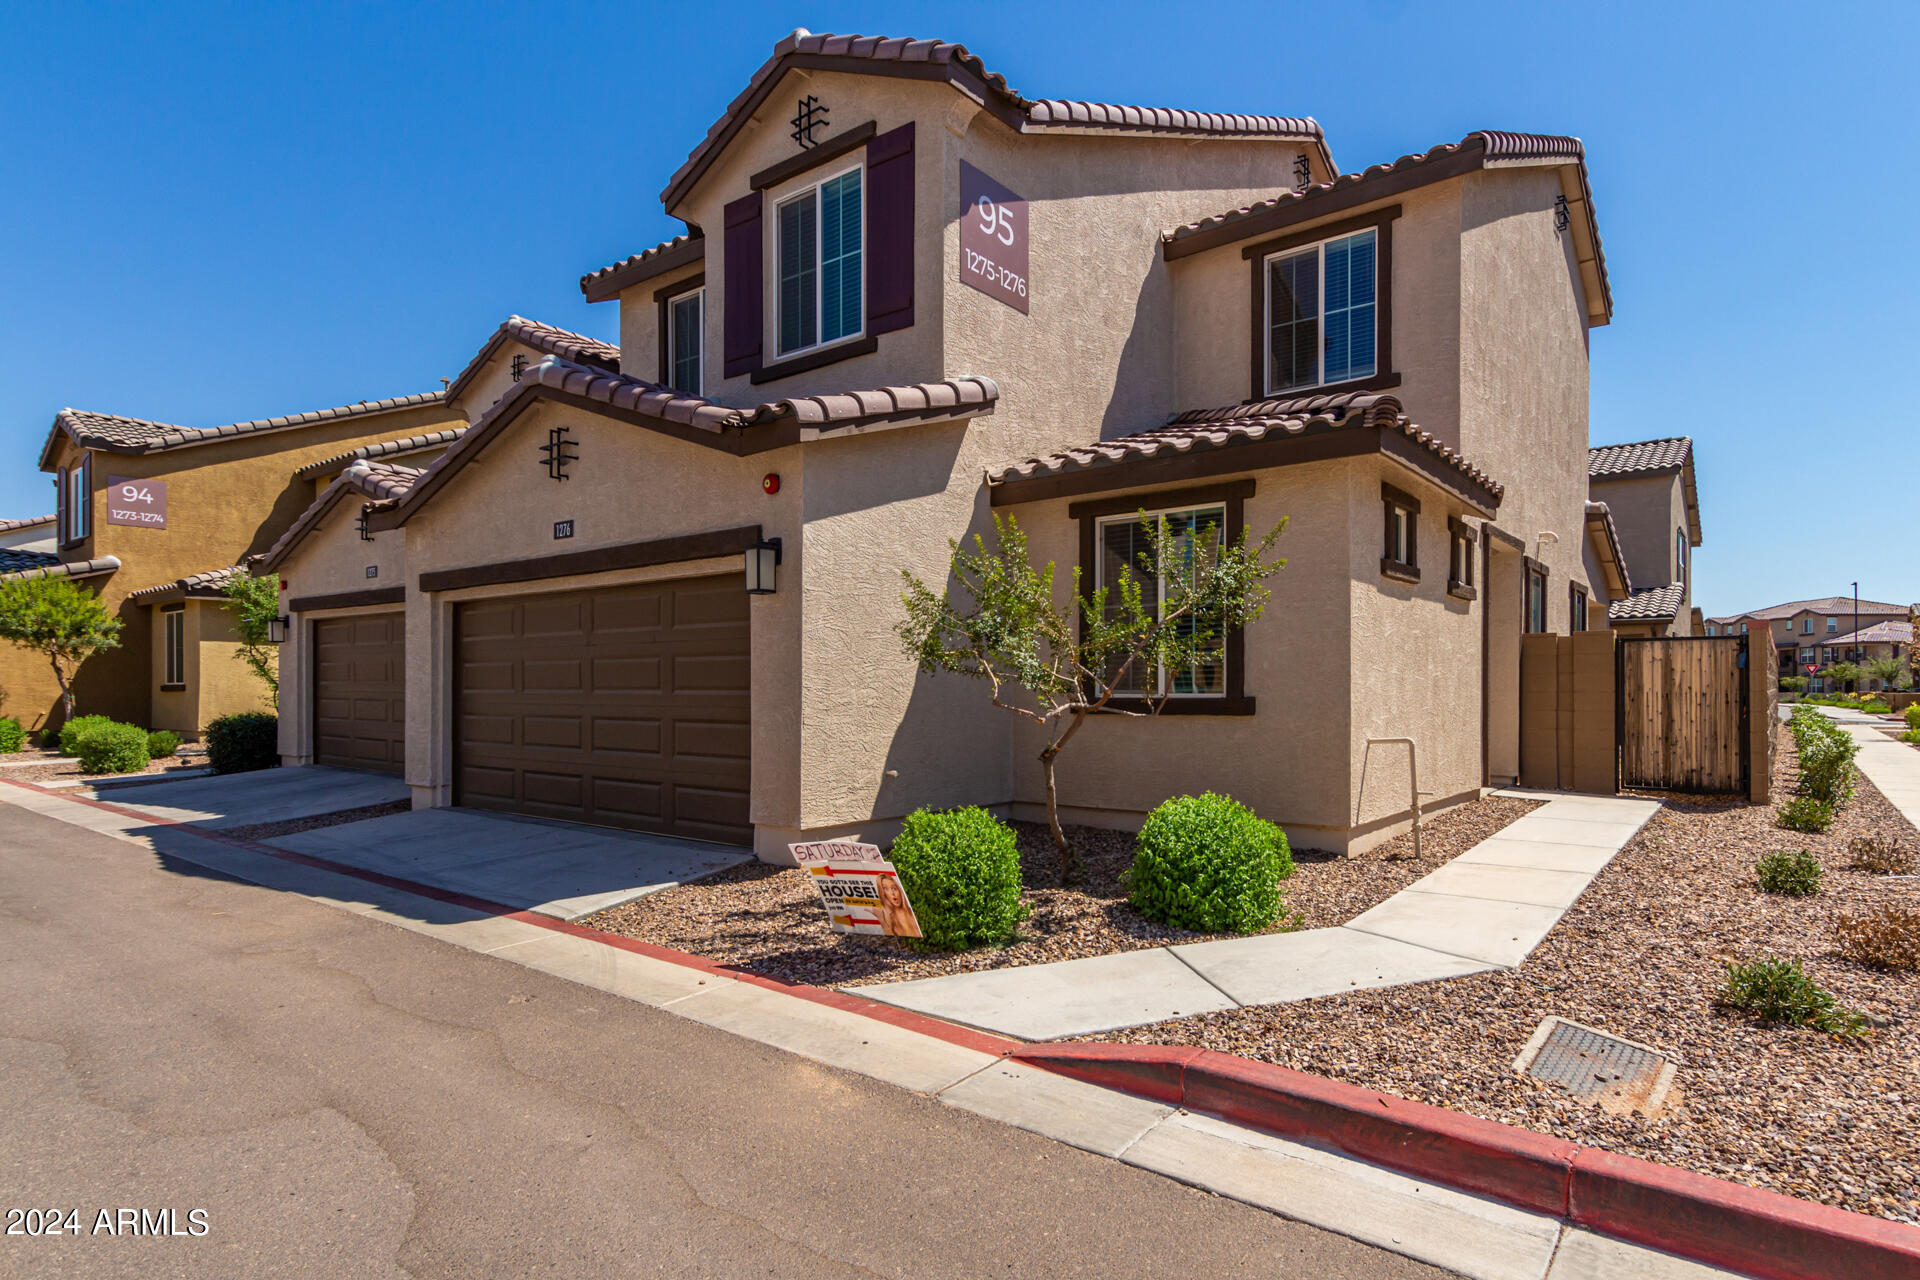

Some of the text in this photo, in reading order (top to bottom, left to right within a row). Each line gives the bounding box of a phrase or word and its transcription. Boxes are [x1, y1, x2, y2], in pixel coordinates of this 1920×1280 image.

[978, 195, 1014, 246] 95
[965, 247, 1027, 297] 1275-1276
[122, 485, 154, 504] 94
[111, 509, 164, 523] 1273-1274
[555, 522, 571, 537] 1276
[794, 843, 865, 860] SATURDAY
[819, 885, 879, 899] HOUSE!
